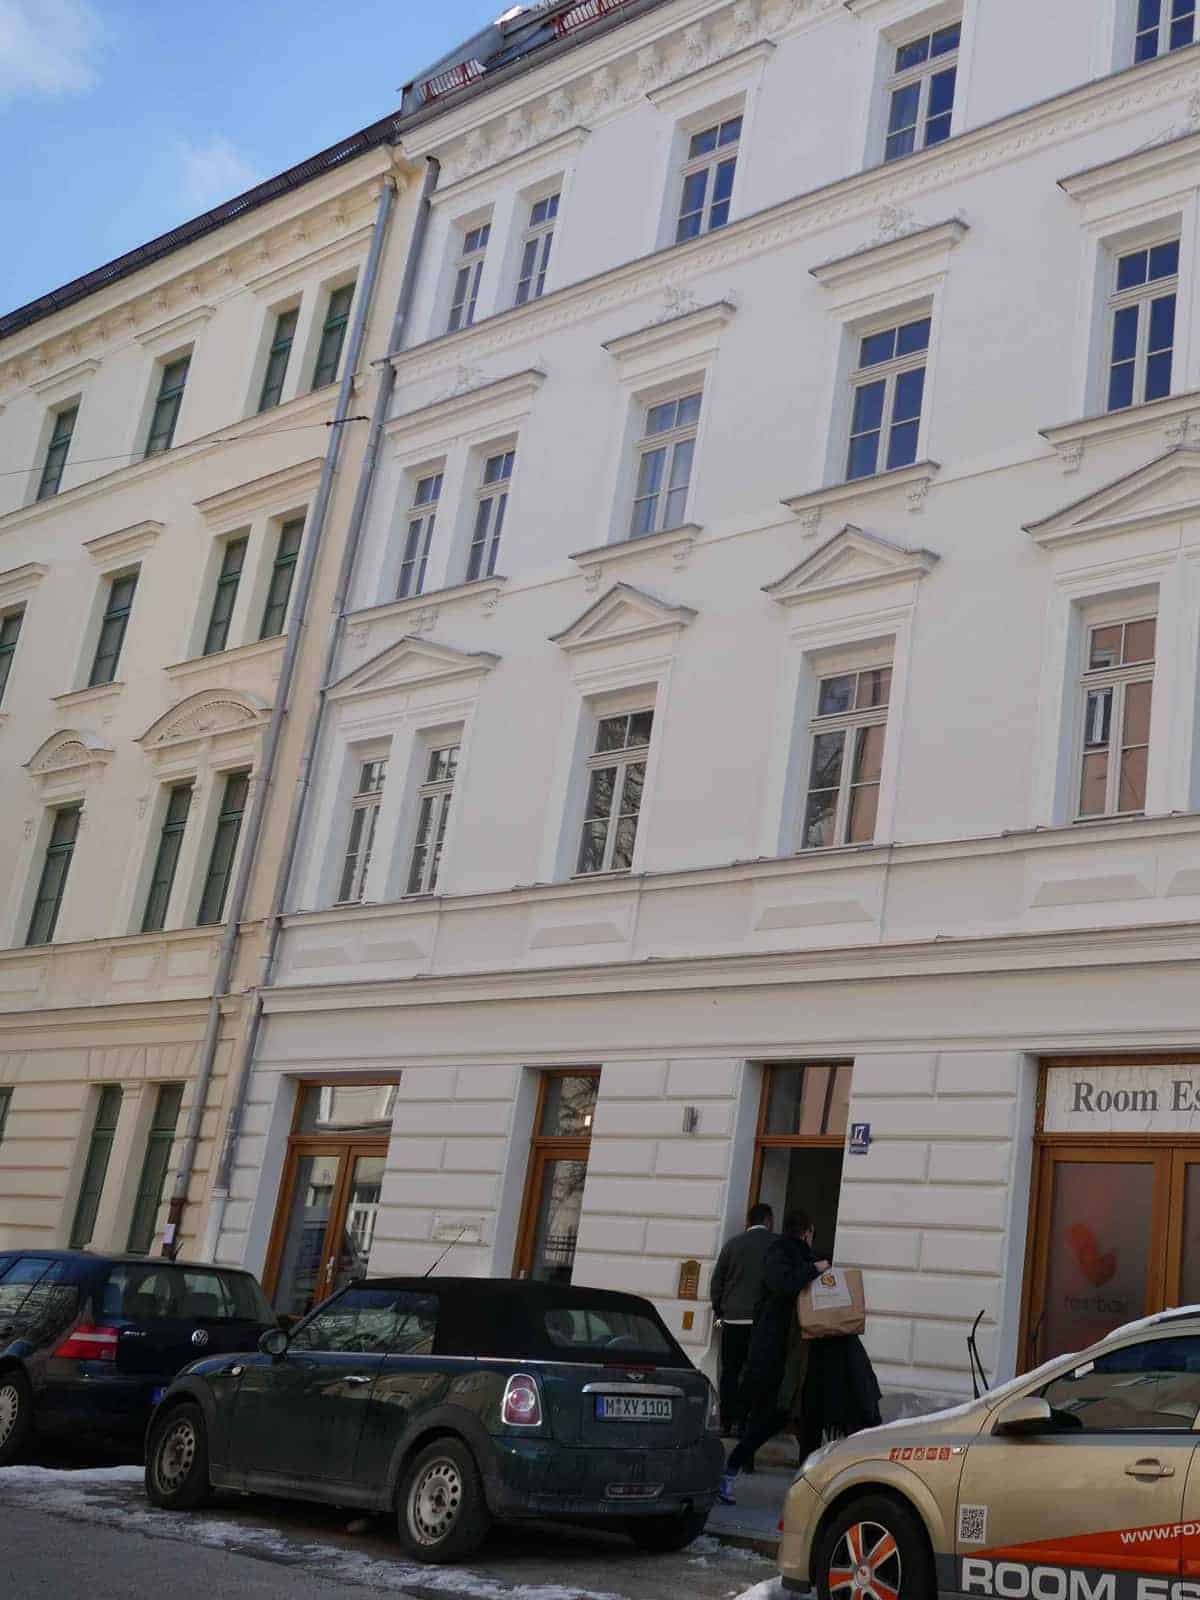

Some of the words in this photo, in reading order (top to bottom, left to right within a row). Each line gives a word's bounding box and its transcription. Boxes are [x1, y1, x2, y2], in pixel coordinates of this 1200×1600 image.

[1071, 1081, 1159, 1113] Room
[641, 1401, 671, 1417] 1101
[961, 1557, 1117, 1600] ROOM
